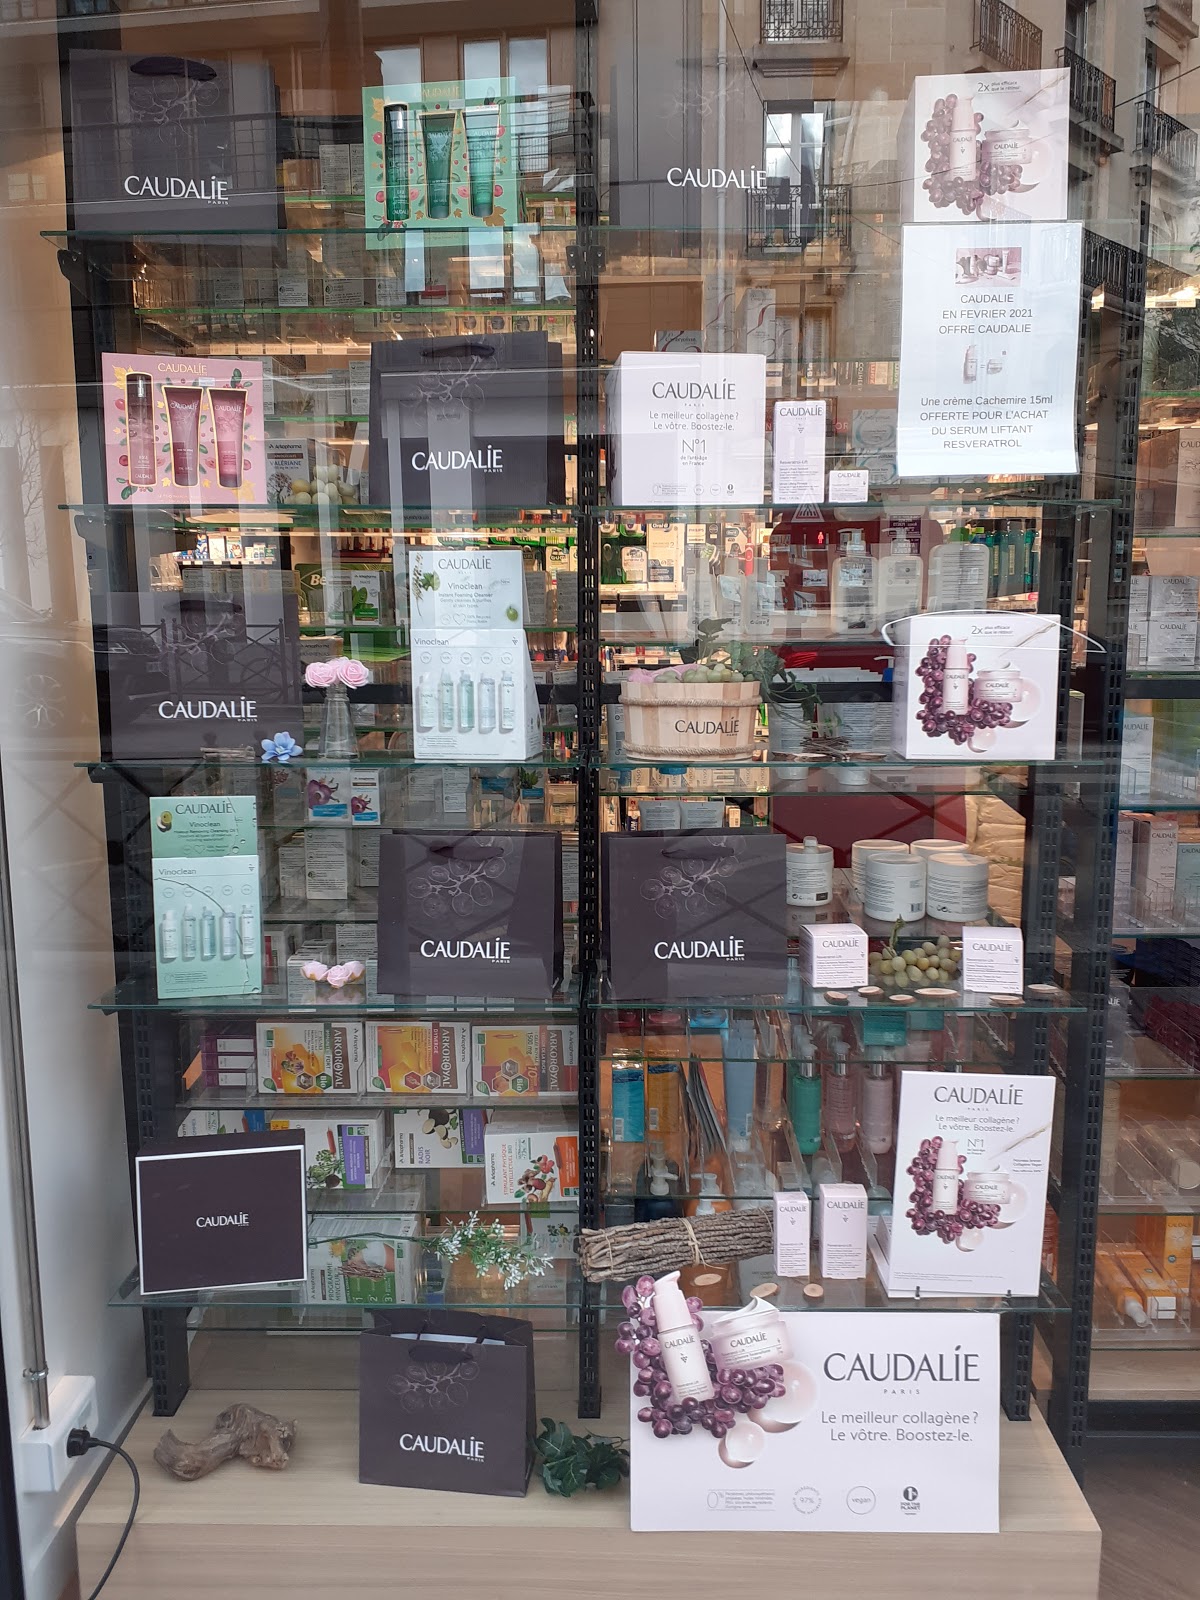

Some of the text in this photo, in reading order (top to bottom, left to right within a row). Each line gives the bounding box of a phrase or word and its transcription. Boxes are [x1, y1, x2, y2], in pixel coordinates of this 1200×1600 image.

[960, 294, 1014, 304] CAUDALIE
[942, 308, 1033, 320] EN FEVRIER 2021
[938, 324, 1032, 335] OFFRE CAUDALIE
[921, 394, 1053, 407] Une crème Cachemire 15ml
[649, 411, 659, 420] Le
[661, 411, 694, 420] meilleur
[920, 410, 1049, 421] OFFERTE POUR L'ACHAT
[653, 422, 663, 430] Le
[691, 421, 735, 431] Boostez-le.
[931, 425, 1034, 436] DU SERUM LIFTANT
[943, 440, 1022, 449] RESVERATROL
[447, 582, 483, 590] Vinoclean
[414, 637, 449, 646] Vinoclean
[158, 868, 197, 876] Vinoclean
[935, 1114, 944, 1122] Le
[946, 1114, 976, 1123] meilleur
[974, 1124, 1015, 1133] Boostez-le.
[821, 1411, 837, 1424] Le
[841, 1411, 899, 1424] meilleur
[830, 1428, 973, 1442] Le vôtre. Boostez-le.
[799, 1496, 815, 1504] 97%
